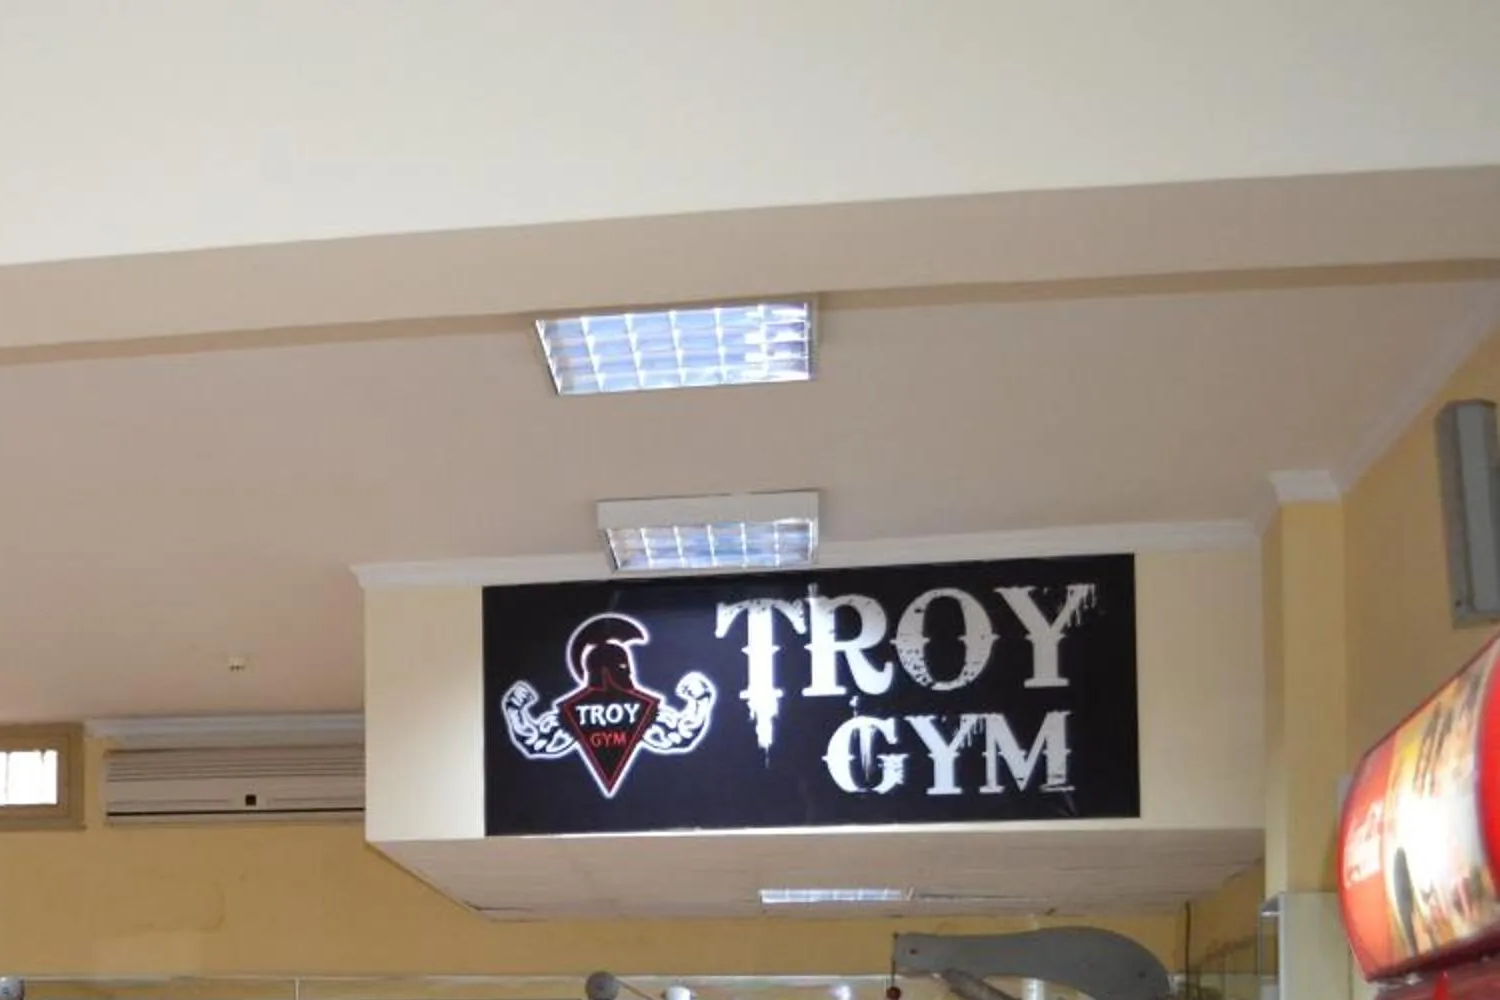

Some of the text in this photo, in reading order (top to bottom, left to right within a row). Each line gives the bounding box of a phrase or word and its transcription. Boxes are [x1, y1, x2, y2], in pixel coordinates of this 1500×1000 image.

[714, 582, 1098, 760] TROY
[575, 703, 640, 727] TROY
[591, 731, 628, 748] GYM
[821, 708, 1075, 796] GYM
